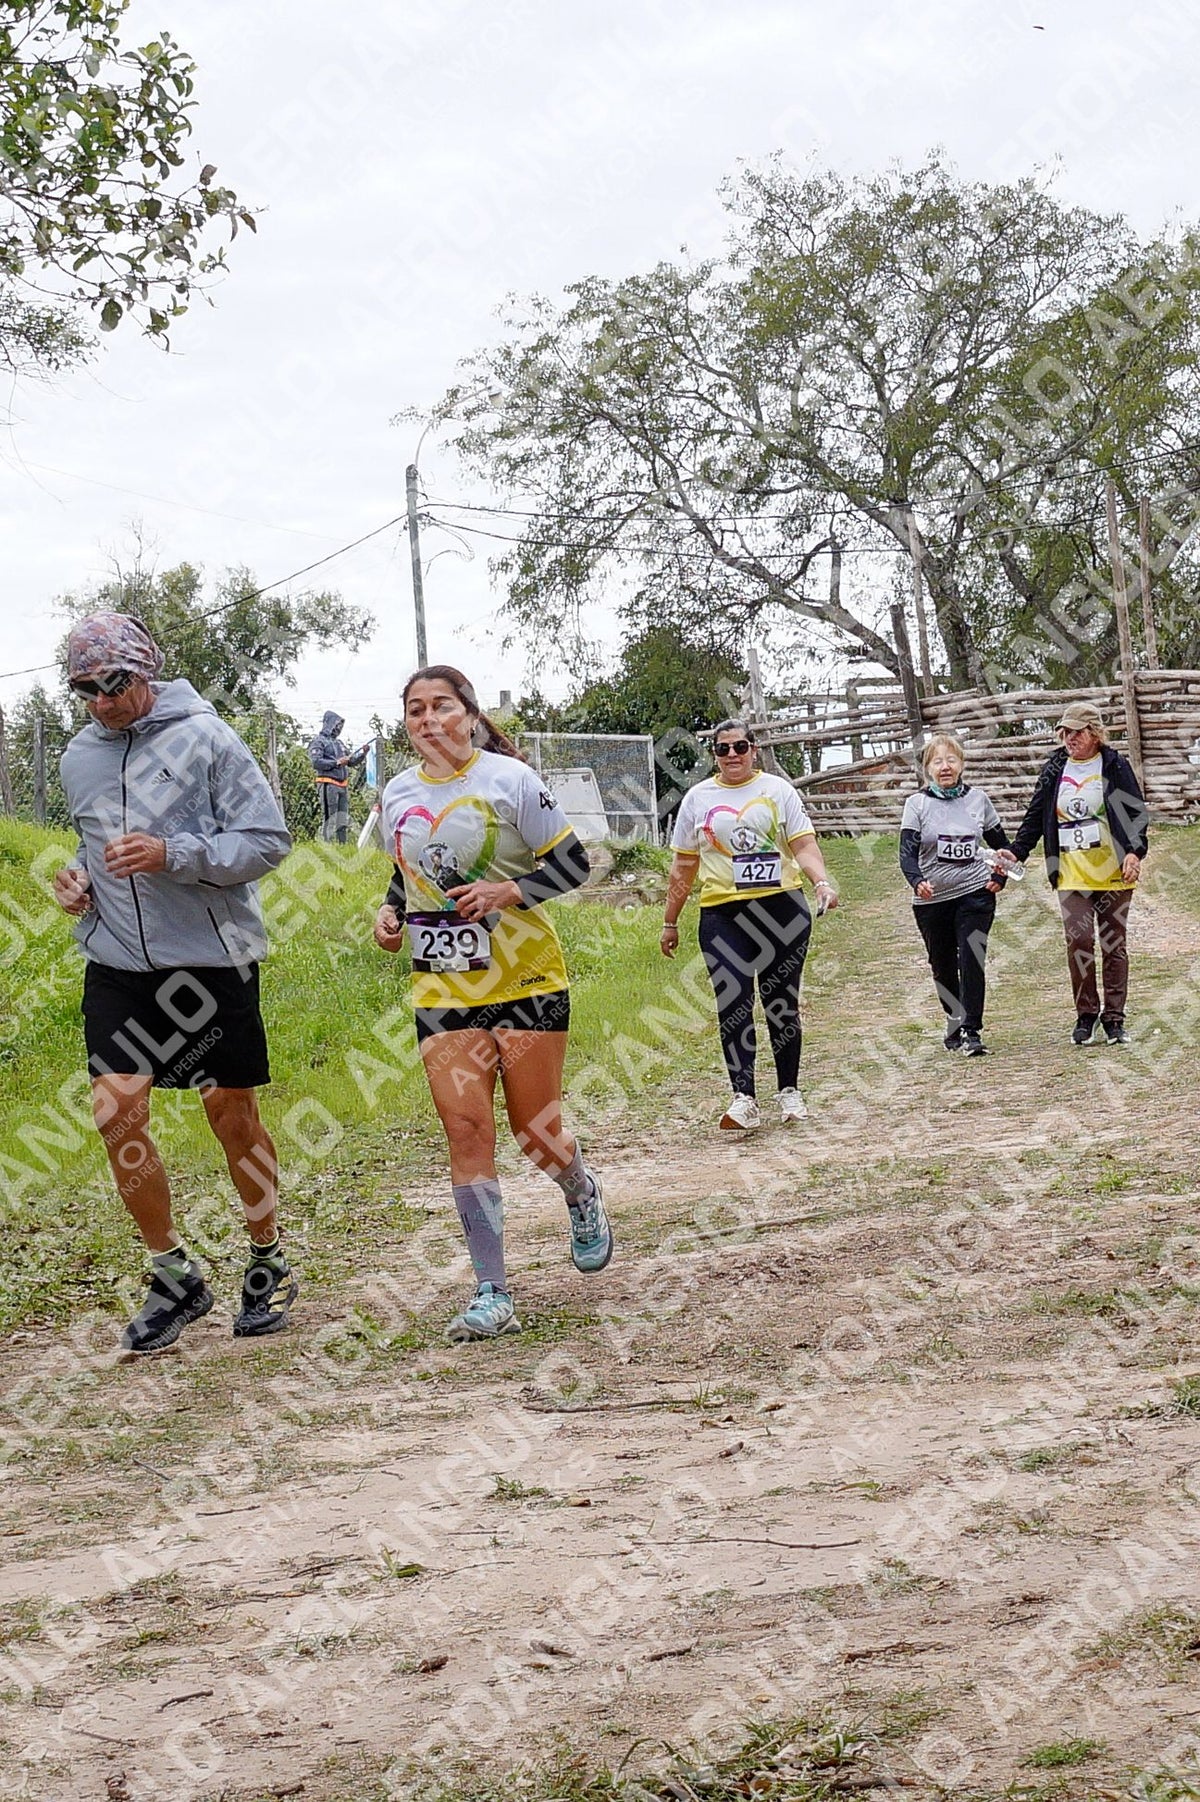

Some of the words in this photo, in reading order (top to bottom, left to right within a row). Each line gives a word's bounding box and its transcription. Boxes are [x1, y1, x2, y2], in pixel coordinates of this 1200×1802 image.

[1073, 829, 1084, 844] 8
[943, 843, 972, 859] 466
[741, 863, 776, 881] 427
[420, 928, 479, 960] 239
